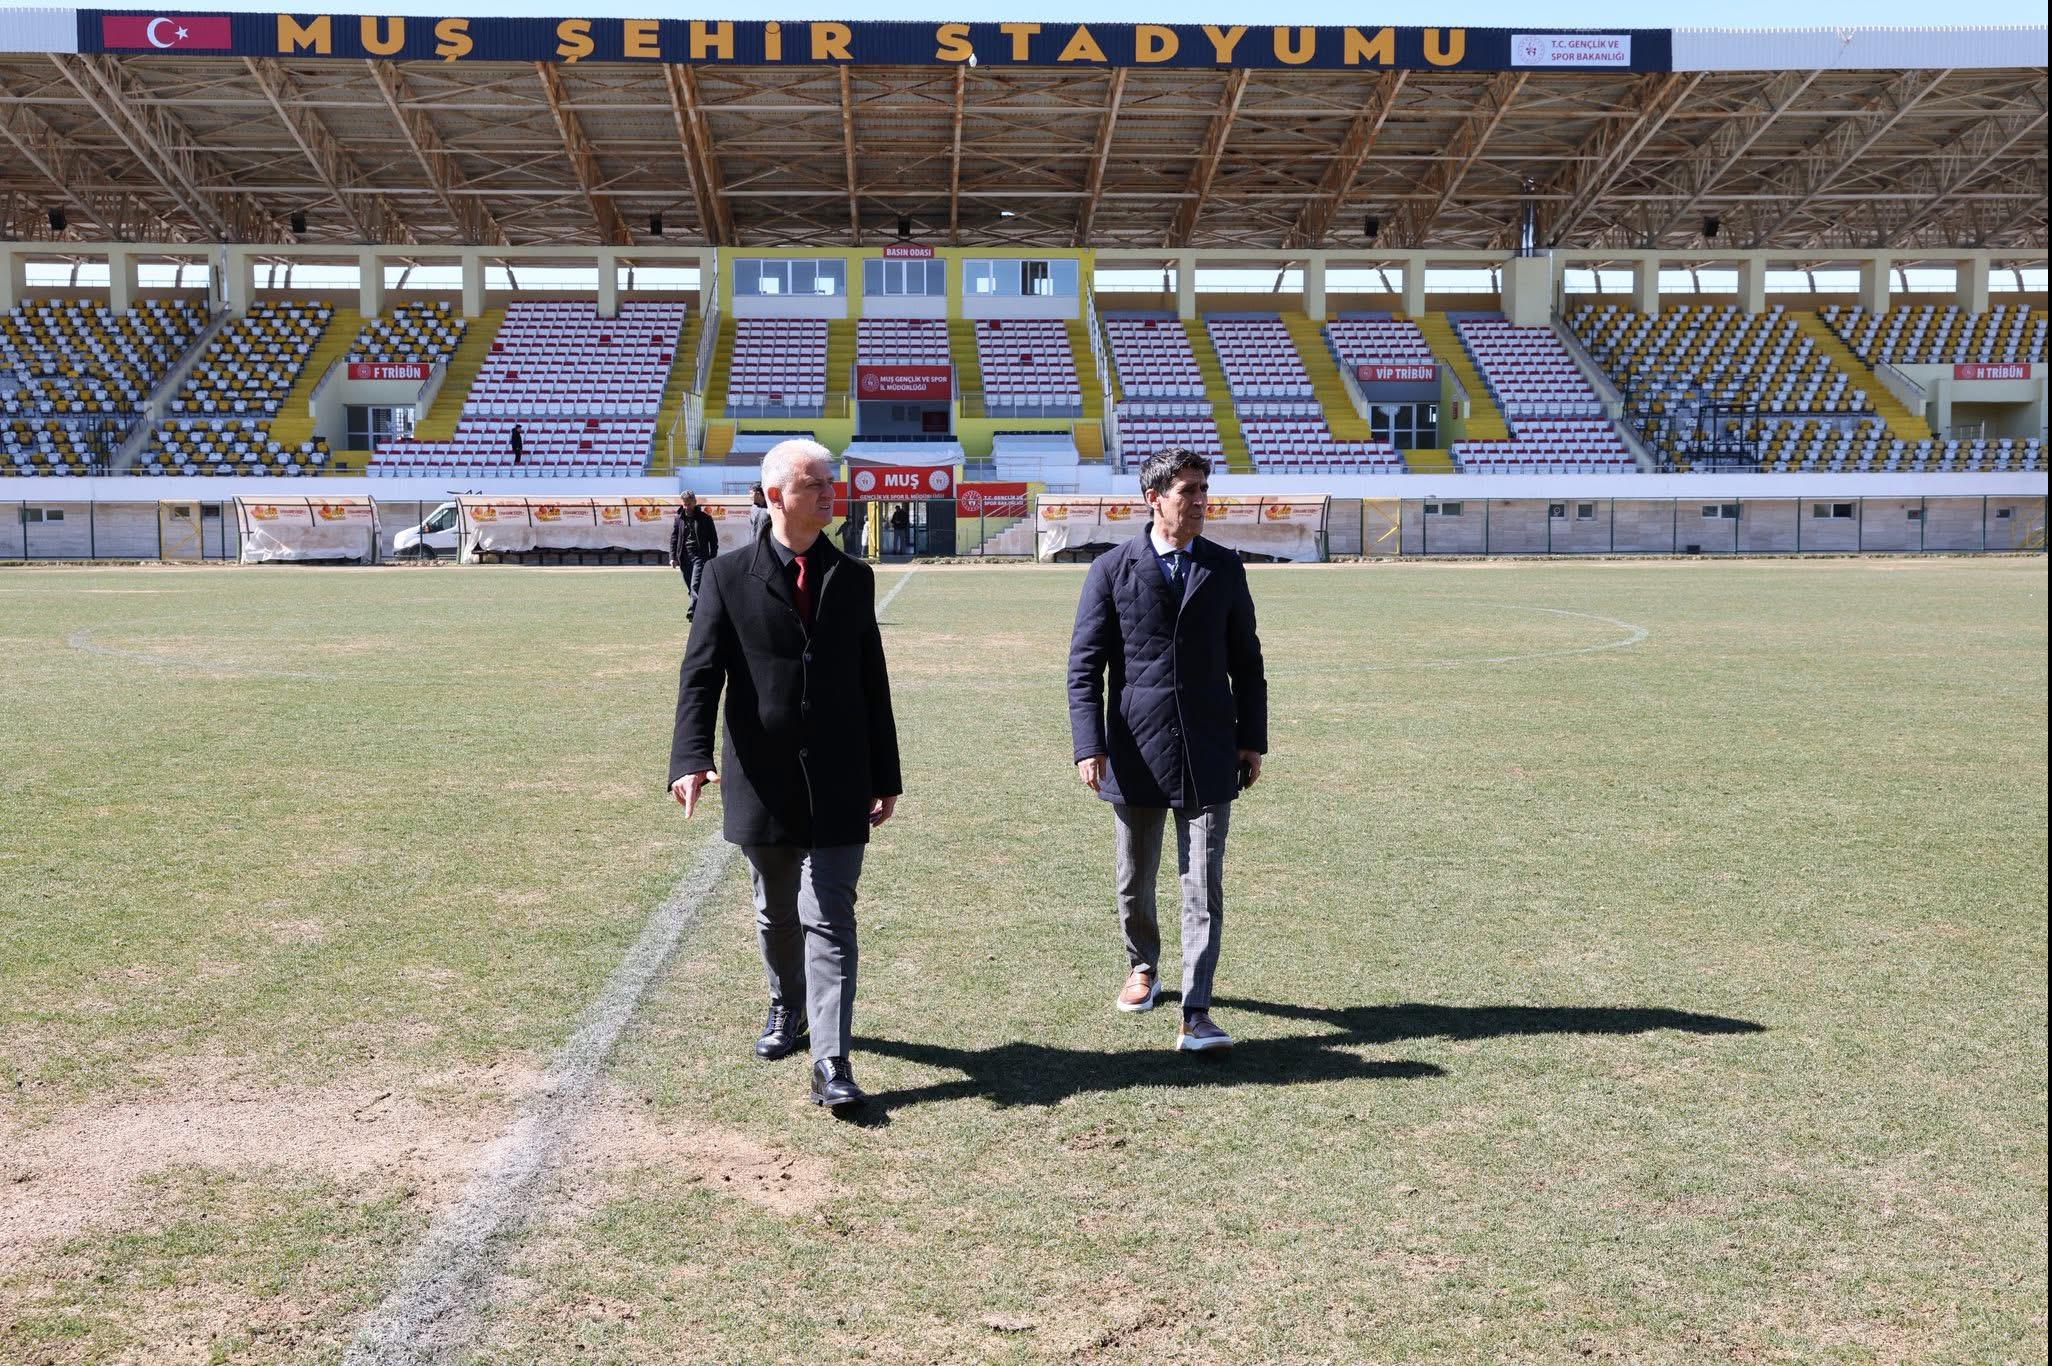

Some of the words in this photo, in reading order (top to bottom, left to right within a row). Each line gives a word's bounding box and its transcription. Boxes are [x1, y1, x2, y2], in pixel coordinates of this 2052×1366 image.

[277, 14, 474, 62] MUŞ
[936, 22, 1466, 66] STADYUMU
[1551, 40, 1567, 49] T.C.
[1568, 39, 1606, 50] GENÇLİK
[1607, 40, 1620, 49] VE
[1551, 52, 1575, 61] SPOR
[1576, 51, 1625, 61] BAKANLIĞI
[886, 248, 909, 257] BASIN
[910, 248, 932, 257] ODASI
[374, 367, 380, 379] F
[382, 364, 421, 379] TRİBÜN
[1376, 366, 1393, 379] VİP
[1395, 366, 1433, 380] TRİBÜN
[1977, 367, 1985, 379] H
[1986, 365, 2024, 379] TRİBÜN
[895, 375, 921, 383] GENÇLİK
[884, 474, 920, 490] MUŞ
